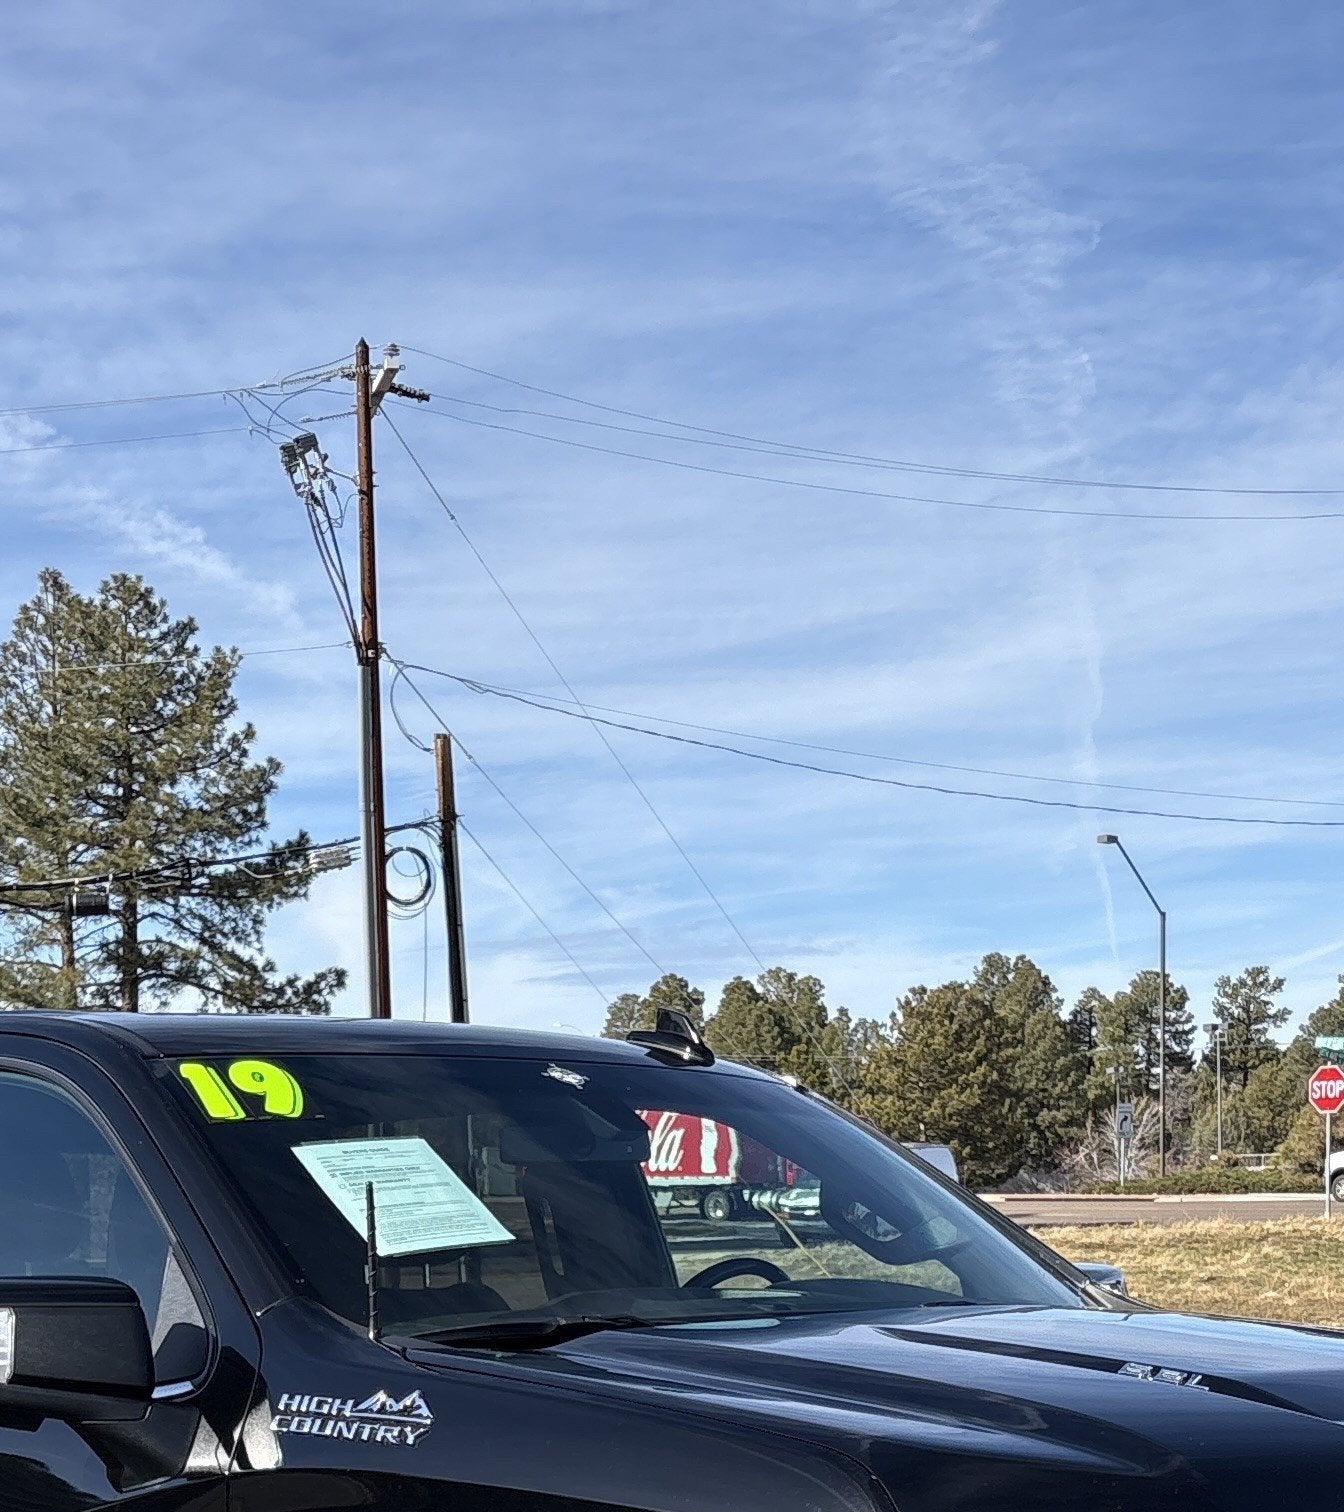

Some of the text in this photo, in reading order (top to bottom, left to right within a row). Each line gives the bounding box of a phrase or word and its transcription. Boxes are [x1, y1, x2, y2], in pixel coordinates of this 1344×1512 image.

[179, 1060, 304, 1120] 19
[1311, 1080, 1344, 1099] STOP
[277, 1393, 356, 1417] HIGH
[269, 1414, 430, 1445] COUNTRY
